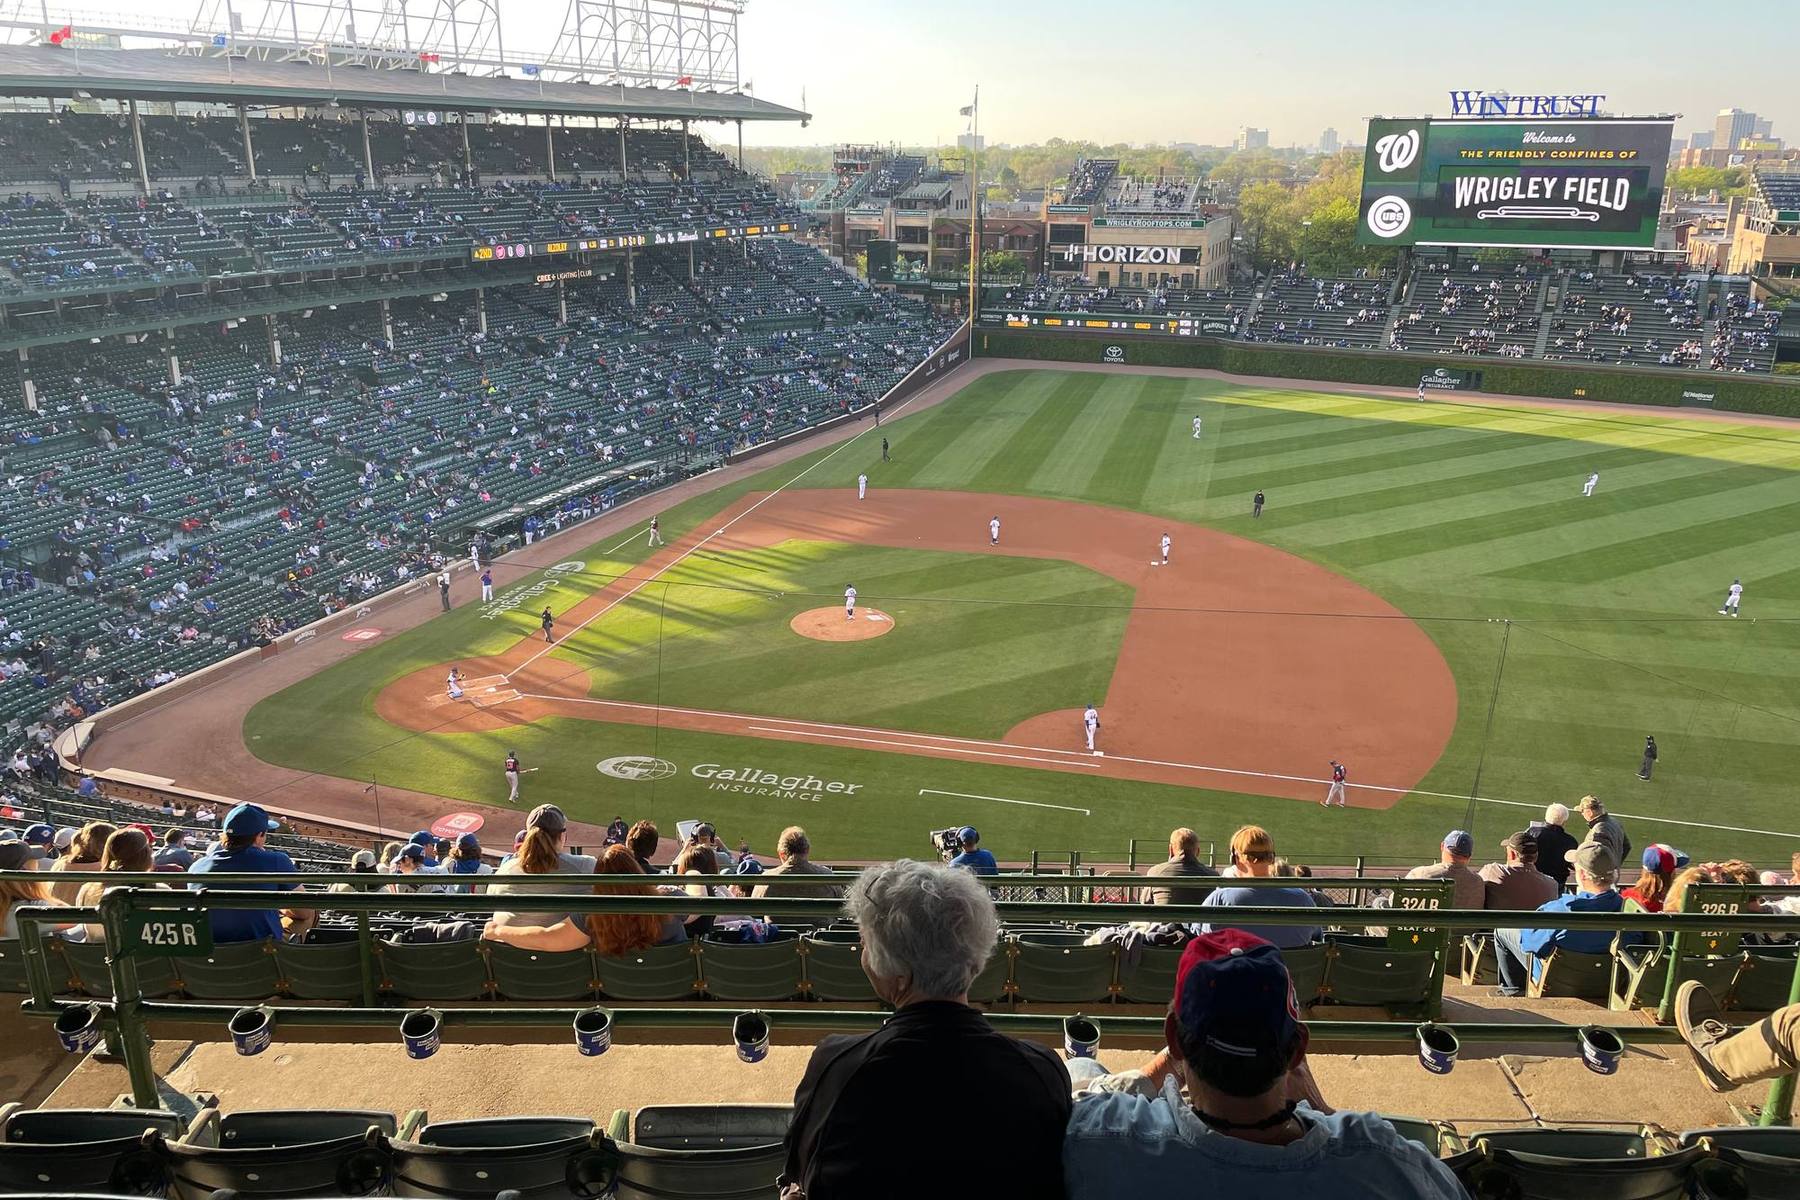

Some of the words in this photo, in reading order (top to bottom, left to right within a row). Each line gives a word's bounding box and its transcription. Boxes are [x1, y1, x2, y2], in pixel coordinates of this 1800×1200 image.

[1449, 90, 1606, 116] WINTRUST
[1522, 131, 1564, 143] Welcome
[1565, 133, 1576, 143] to
[1375, 129, 1420, 173] W
[1460, 150, 1484, 158] THE
[1488, 150, 1546, 158] FRIENDLY
[1550, 151, 1614, 159] CONFINES
[1619, 151, 1637, 159] OF
[1455, 176, 1558, 209] WRIGLEY
[1563, 177, 1630, 211] FIELD
[1106, 218, 1192, 227] WRIGLEYROOFTOPS.COM
[1083, 245, 1181, 264] HORIZON
[536, 274, 552, 283] CREE
[556, 271, 578, 280] LIGHTING
[580, 269, 593, 278] CLUB
[1421, 375, 1461, 384] Gallagher
[691, 763, 863, 795] Gallagher
[708, 782, 823, 802] INSURANCE
[141, 922, 179, 945] 425
[181, 923, 198, 946] R
